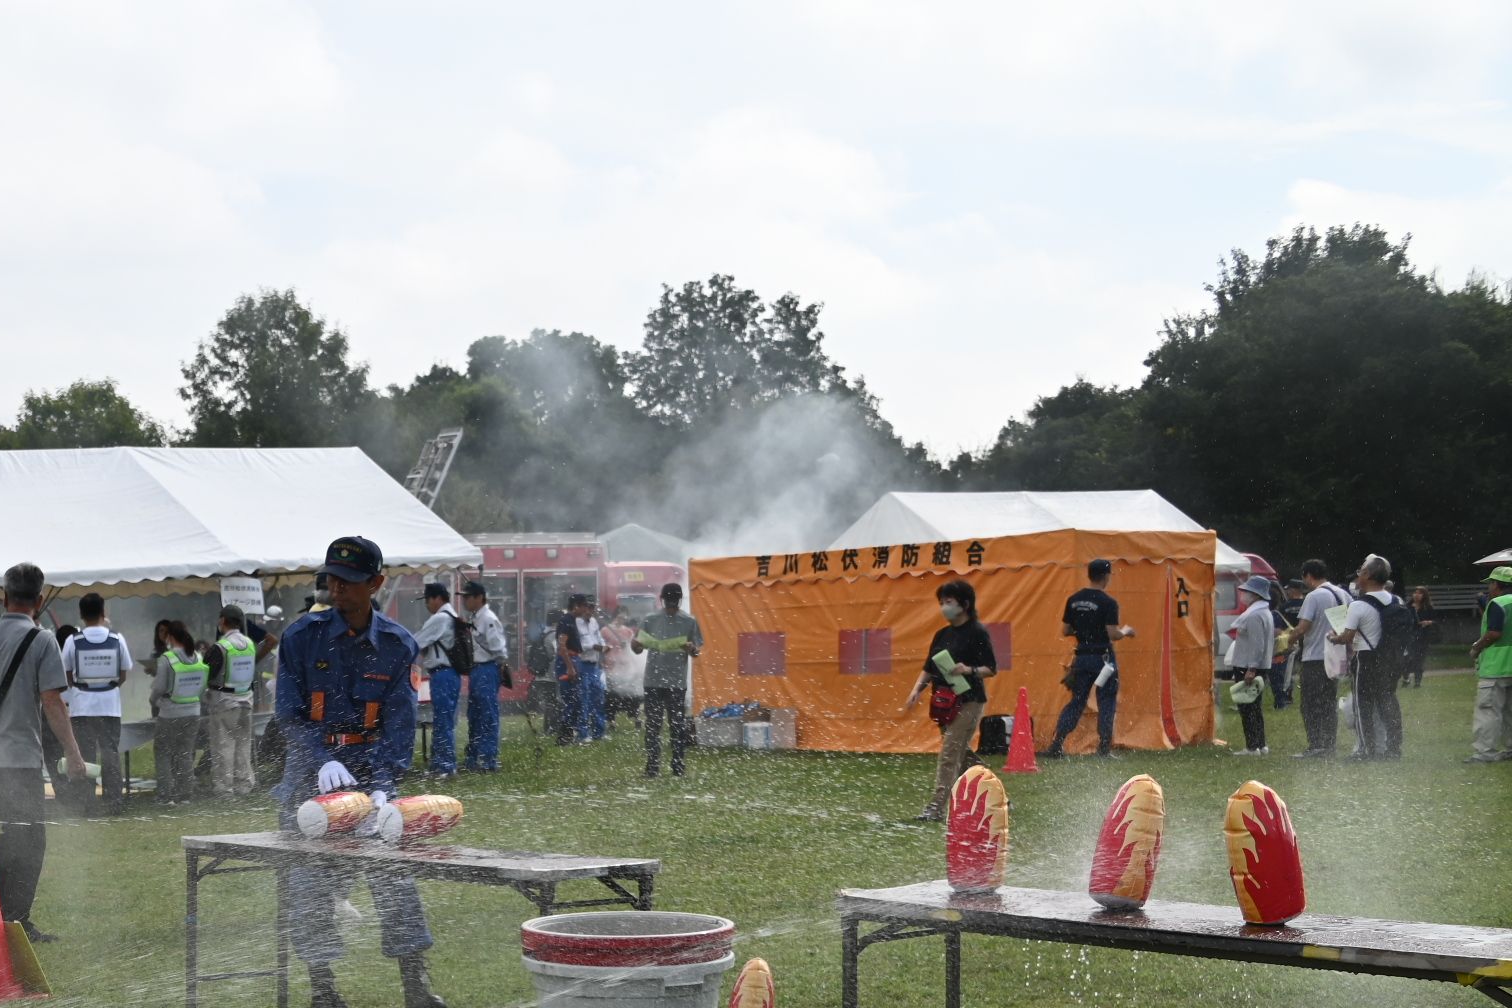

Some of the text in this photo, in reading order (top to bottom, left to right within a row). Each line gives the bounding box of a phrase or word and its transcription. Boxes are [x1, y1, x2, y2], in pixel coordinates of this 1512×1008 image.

[755, 541, 986, 577] 吉川松伏消防組合
[1175, 577, 1190, 618] 入口
